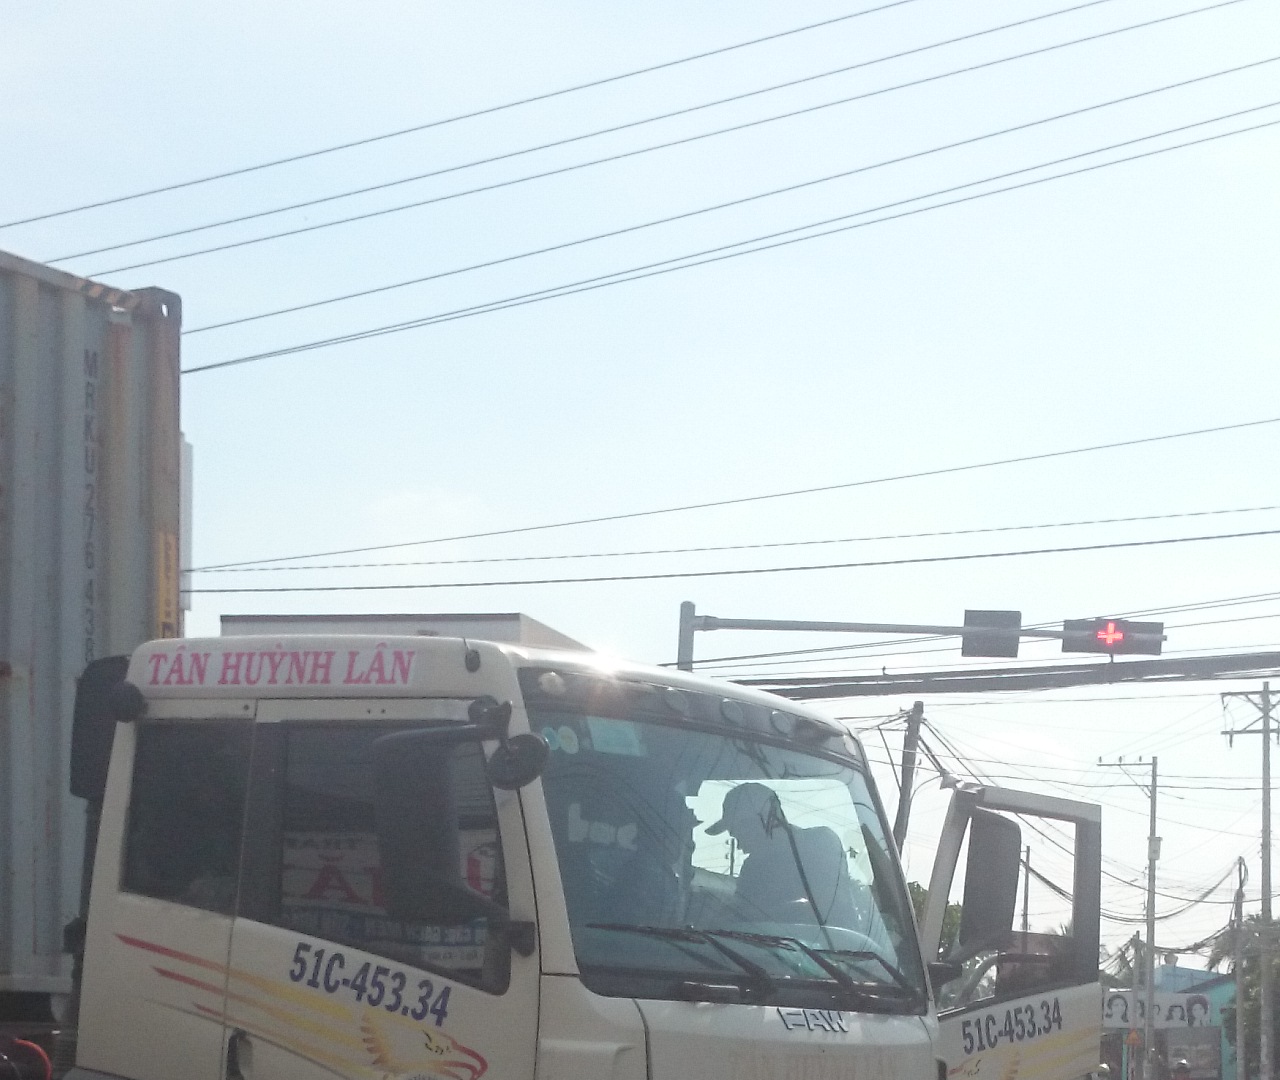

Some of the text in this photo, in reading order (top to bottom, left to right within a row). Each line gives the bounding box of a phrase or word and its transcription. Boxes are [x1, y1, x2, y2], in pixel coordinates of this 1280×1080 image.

[147, 646, 211, 686] TÂN
[342, 642, 415, 686] LÂN
[289, 942, 452, 1027] 51C-453.34
[962, 997, 1062, 1054] 51C-453.34
